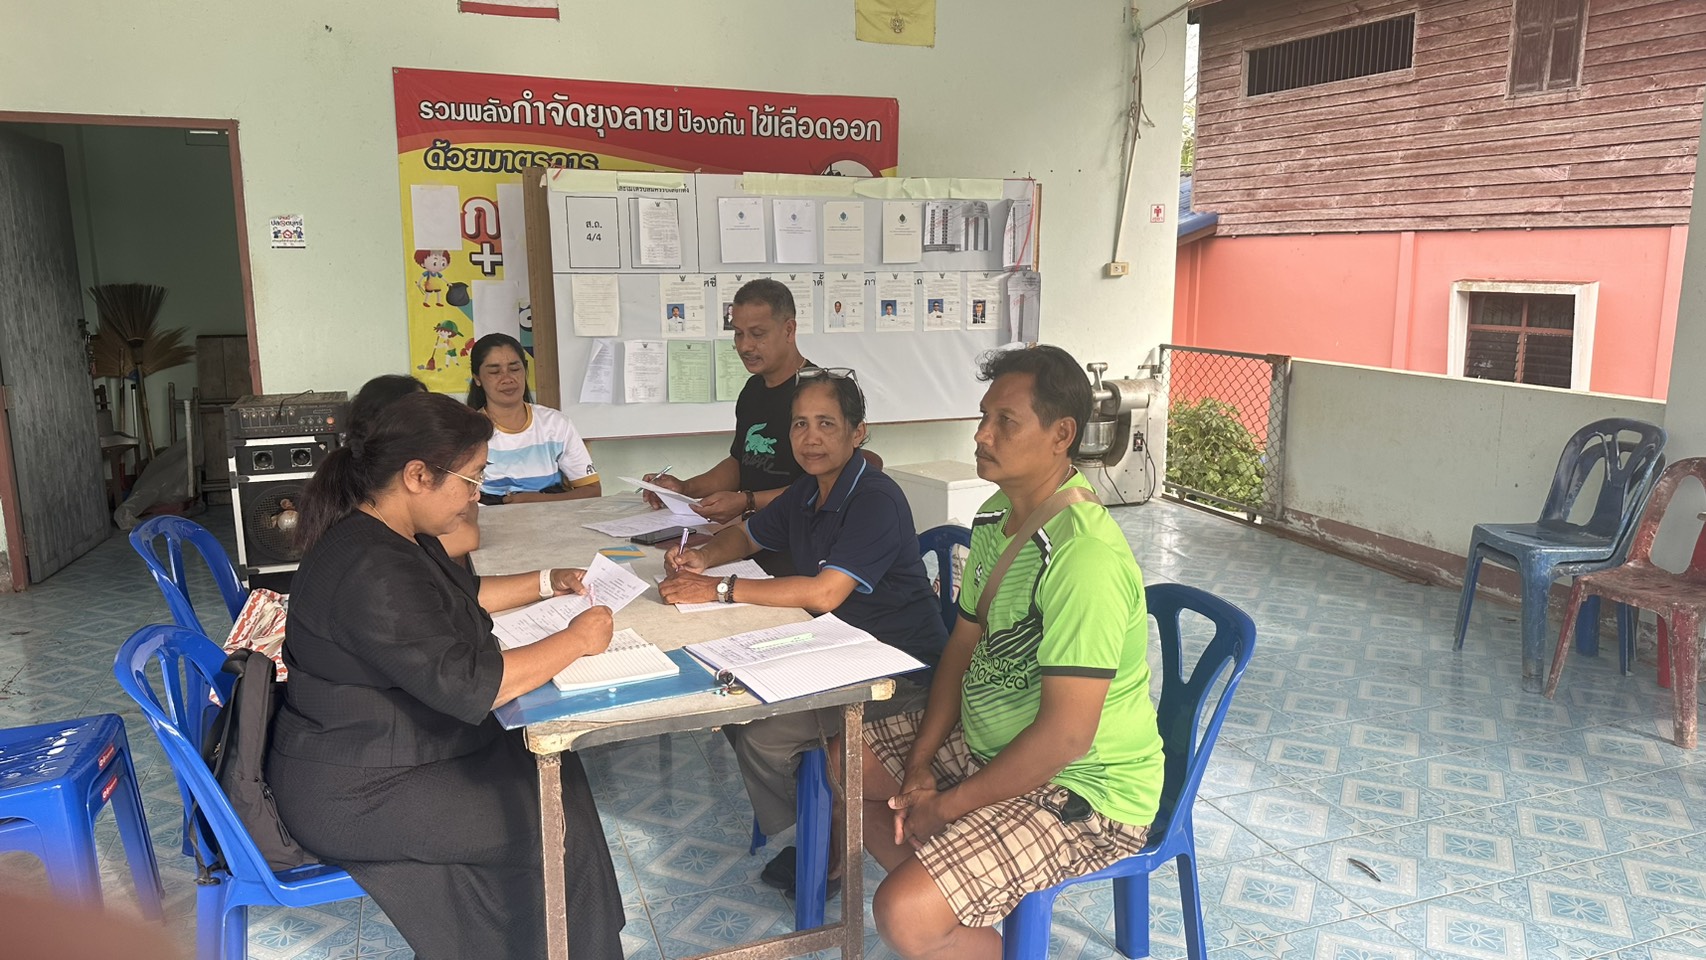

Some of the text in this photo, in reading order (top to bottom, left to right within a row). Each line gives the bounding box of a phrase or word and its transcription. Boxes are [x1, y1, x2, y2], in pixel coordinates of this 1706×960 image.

[419, 90, 882, 141] รวมพลังกำจัดยุงลาย ป้องกัน ไข้เลือดออก
[424, 140, 599, 172] ด้วยมาตรการ
[586, 232, 602, 241] 4/4
